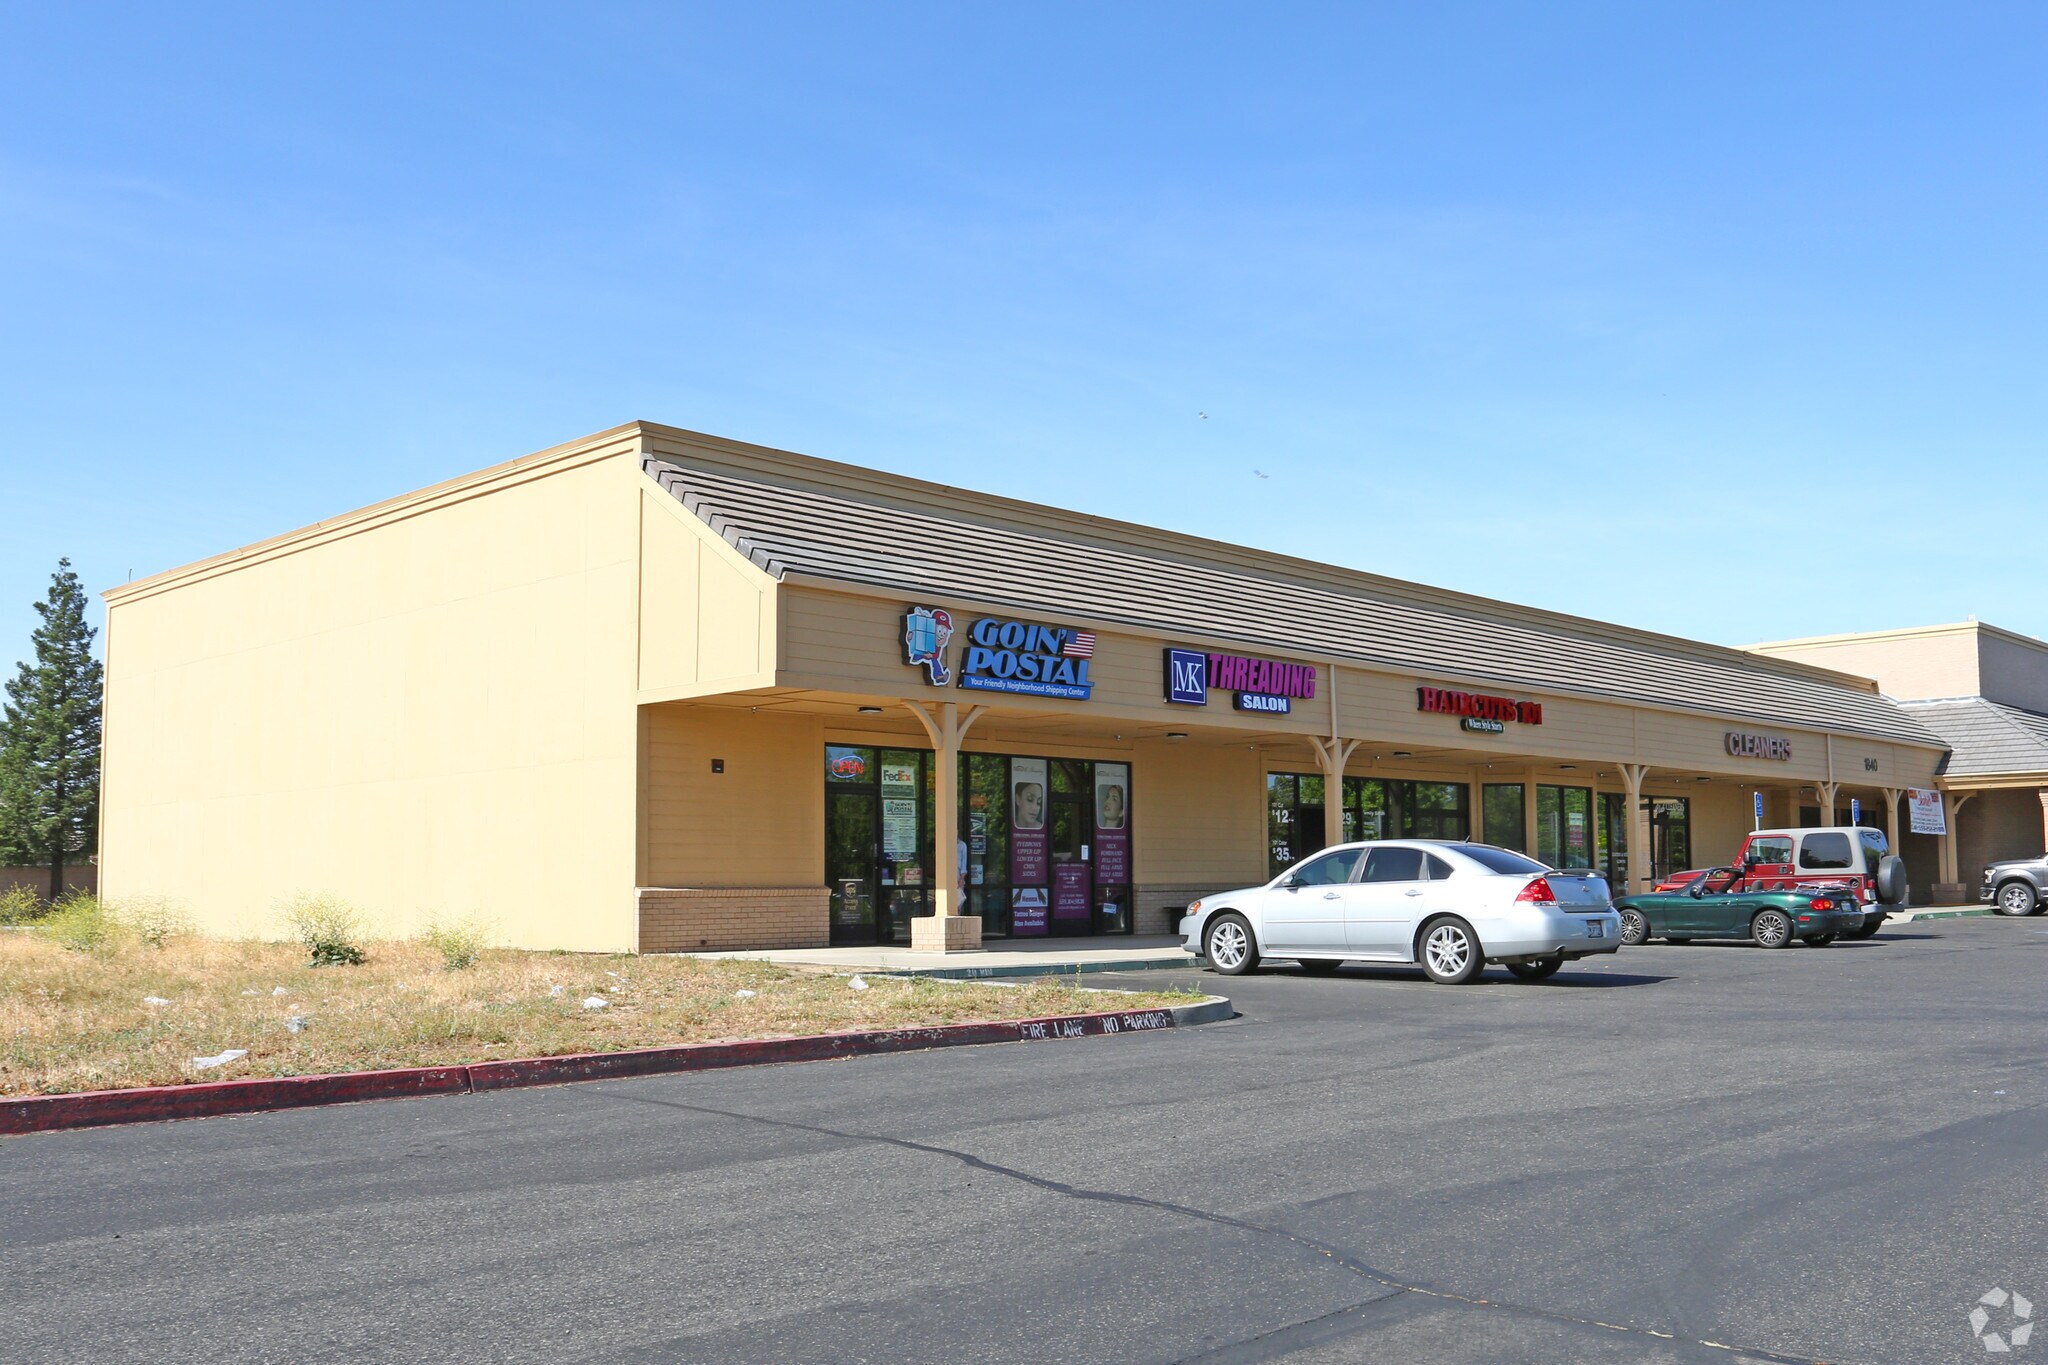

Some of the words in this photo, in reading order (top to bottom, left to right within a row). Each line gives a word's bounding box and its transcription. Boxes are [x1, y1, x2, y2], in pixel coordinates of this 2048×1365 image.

[971, 617, 1068, 655] GOIN'
[965, 646, 1095, 687] POSTAL
[1173, 660, 1203, 694] MK
[1208, 653, 1317, 699] THREADING
[970, 677, 983, 686] Your
[984, 678, 1006, 690] Friendly
[1007, 681, 1045, 693] Neighborhood
[1045, 685, 1068, 696] Shipping
[1068, 687, 1085, 697] Center
[1243, 694, 1287, 712] SALON
[1419, 687, 1517, 721] HAIRCUTS
[1519, 701, 1543, 725] 101
[1728, 732, 1793, 762] CLEANERS
[832, 759, 865, 775] OPEN
[883, 769, 911, 782] FedEx
[1021, 1022, 1048, 1039] FIRE
[1054, 1020, 1085, 1038] LANE
[1101, 1017, 1119, 1033] NO
[1123, 1012, 1168, 1030] PARKING
